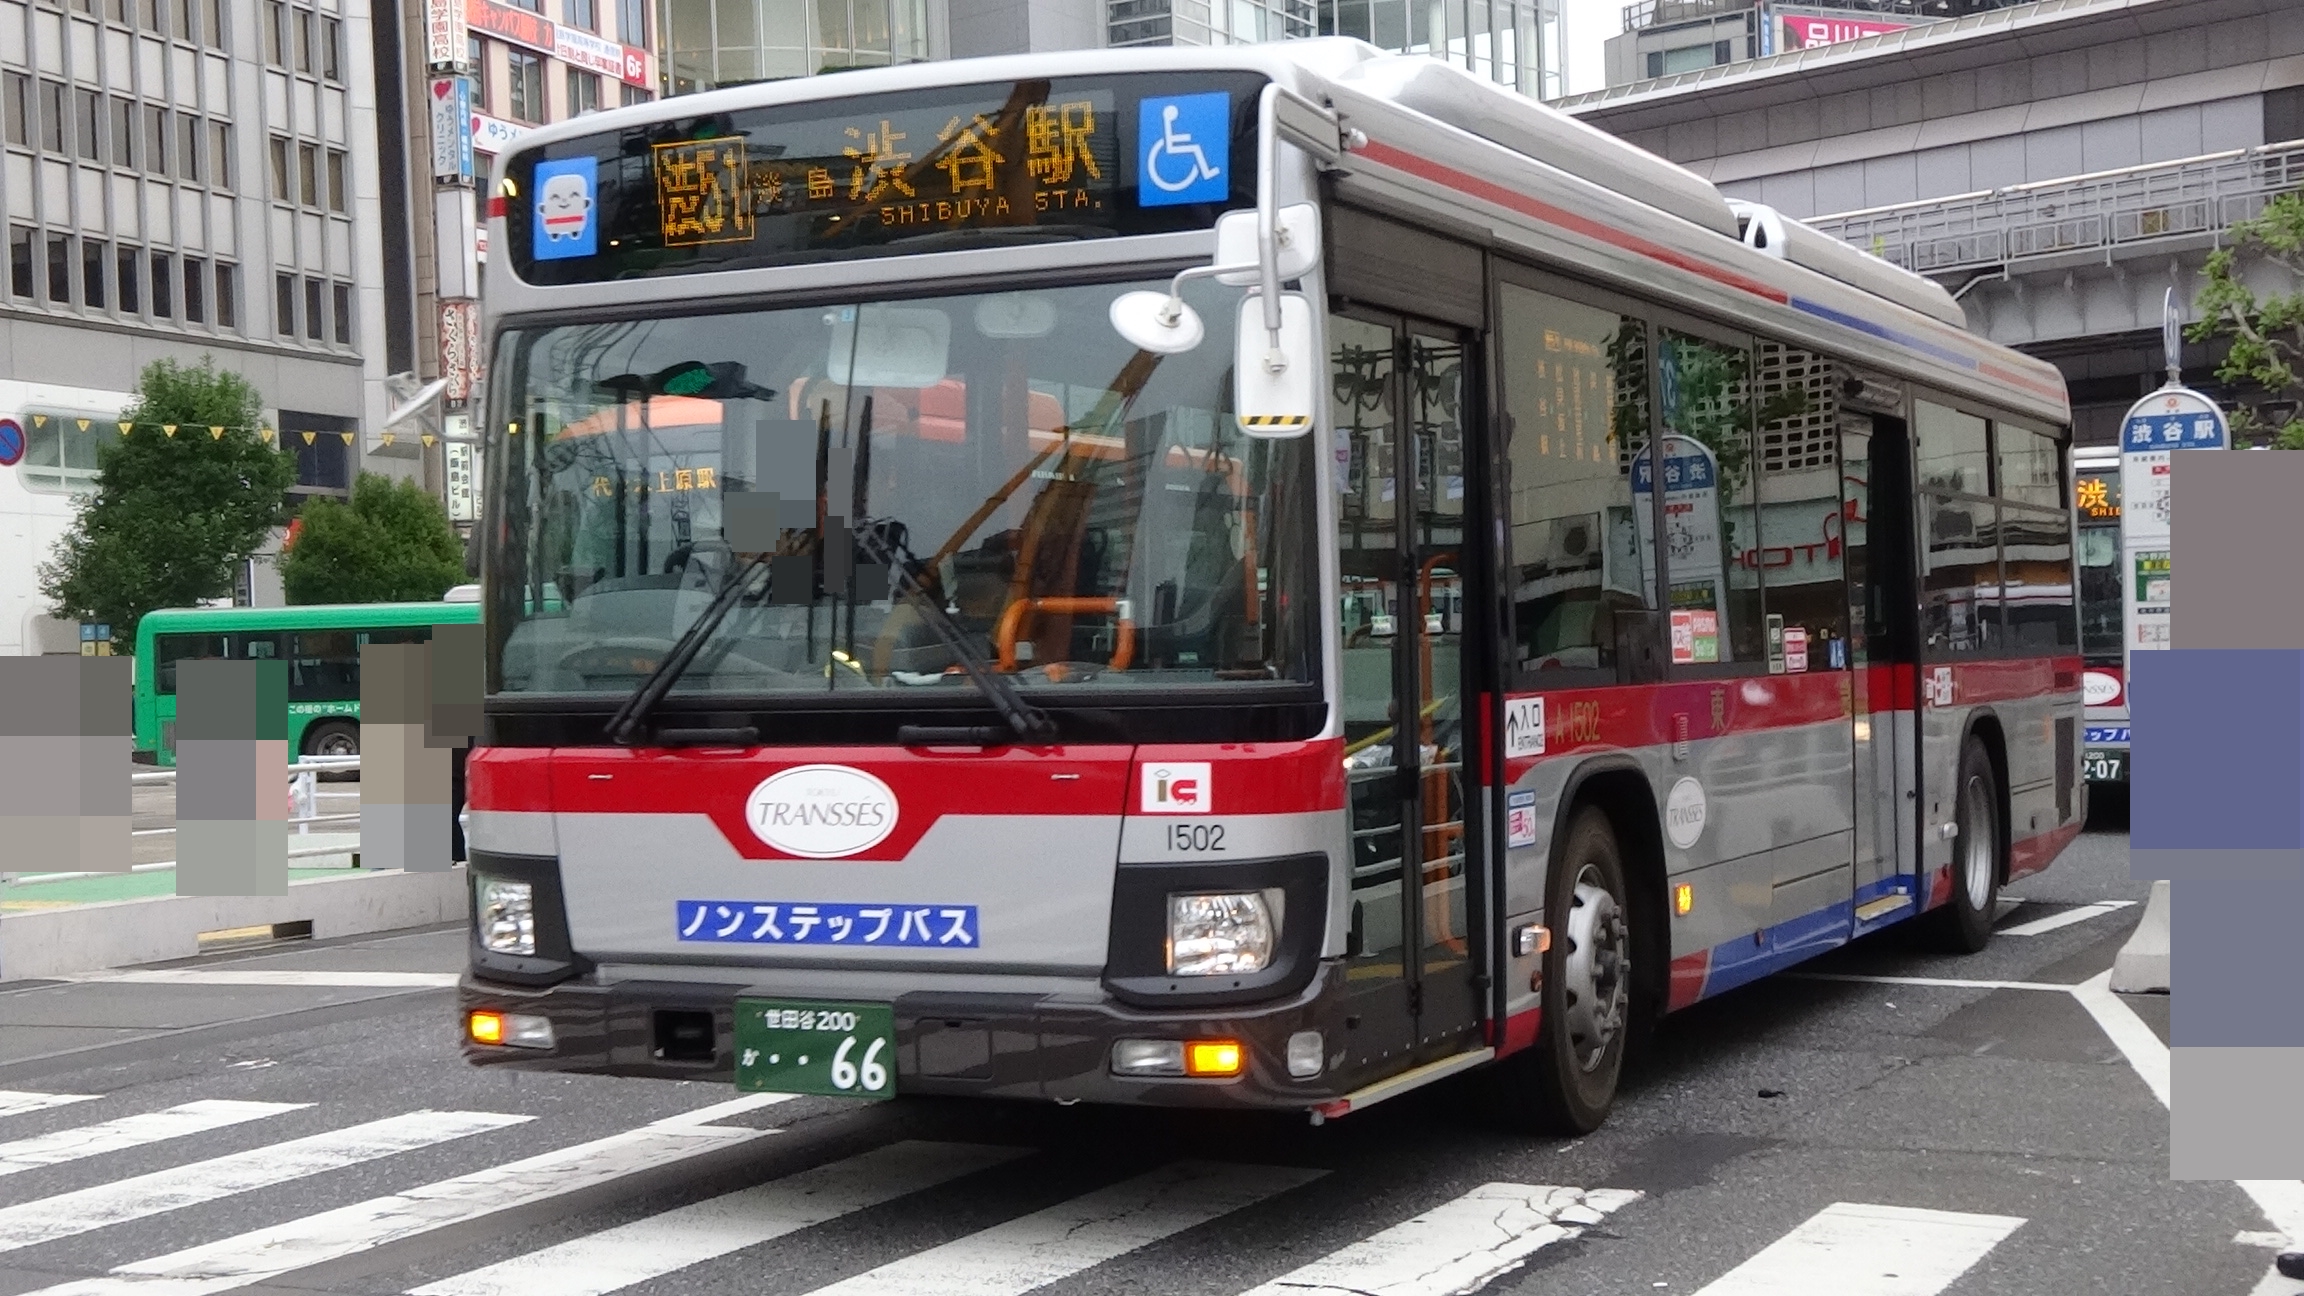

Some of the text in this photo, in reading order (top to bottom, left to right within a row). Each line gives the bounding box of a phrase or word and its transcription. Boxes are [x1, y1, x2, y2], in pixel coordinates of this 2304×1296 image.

[626, 54, 643, 79] 6F
[488, 121, 523, 141] ゆうメ
[841, 100, 1102, 202] 渋谷駅
[880, 188, 1102, 226] SHIBUYA STA.
[2131, 419, 2216, 444] 渋谷駅
[458, 418, 471, 498] 渋駅前会館
[1520, 703, 1541, 731] 入口
[1518, 733, 1544, 751] ENTRANCE
[758, 795, 886, 827] TRANSSÉS
[1167, 824, 1226, 852] 1502
[681, 904, 972, 947] ノンステップバス
